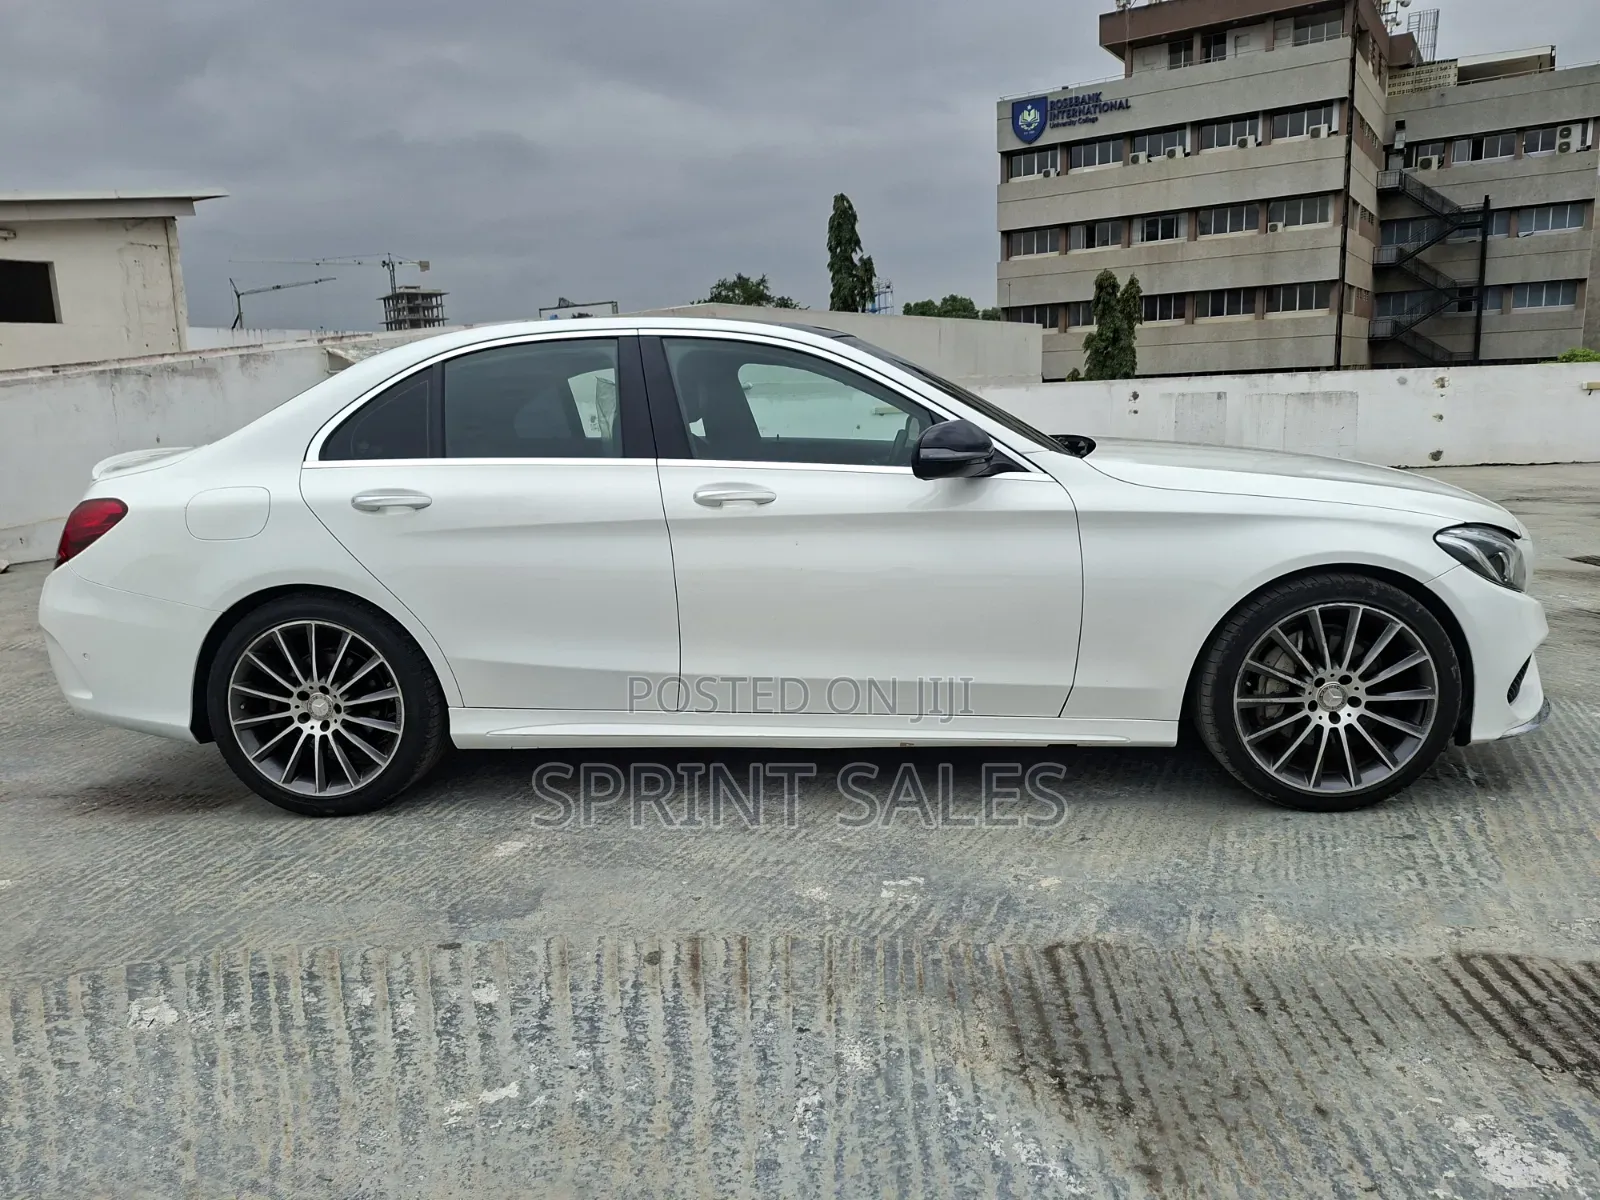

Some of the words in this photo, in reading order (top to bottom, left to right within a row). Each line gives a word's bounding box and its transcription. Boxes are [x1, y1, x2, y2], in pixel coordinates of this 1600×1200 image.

[1049, 99, 1131, 121] INTERNATIONAL
[1050, 92, 1102, 111] ROSEBANK
[1050, 119, 1077, 129] University
[1078, 116, 1098, 124] College
